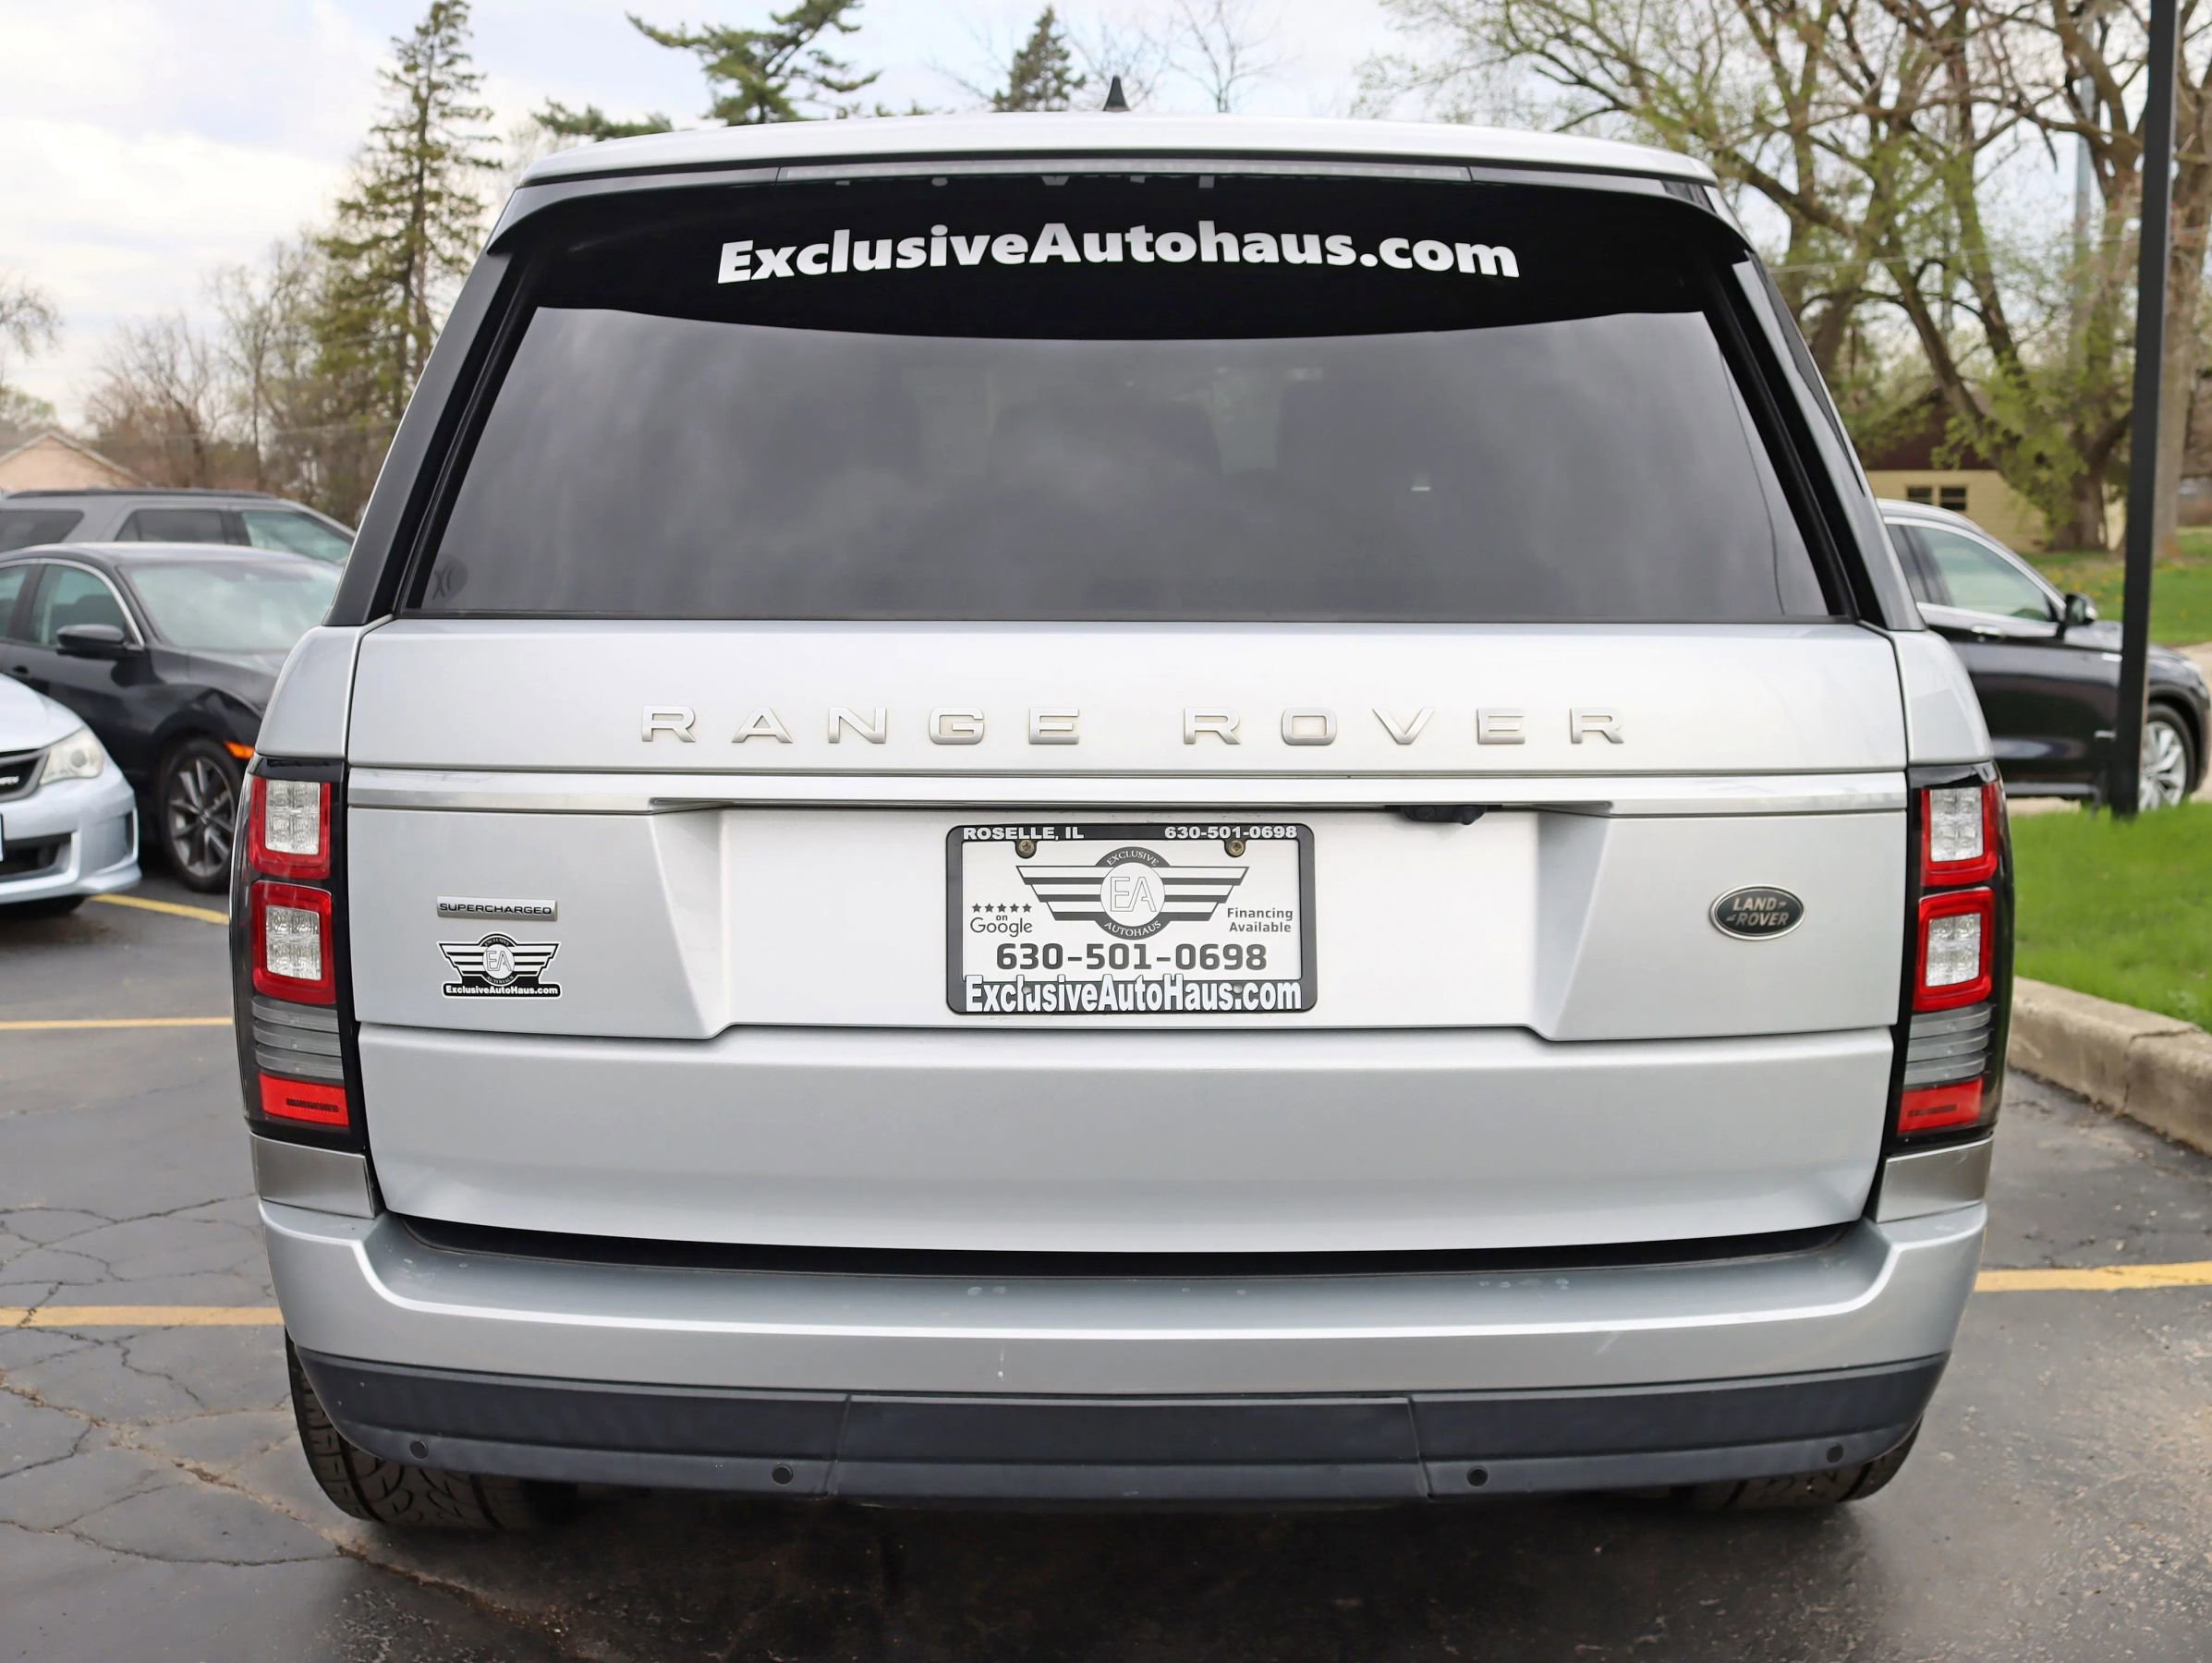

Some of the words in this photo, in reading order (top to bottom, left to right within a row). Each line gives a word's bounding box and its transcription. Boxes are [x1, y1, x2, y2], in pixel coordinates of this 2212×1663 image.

[717, 221, 1520, 285] ExclusiveAutohaus.com
[641, 705, 1080, 746] RANGE
[1184, 706, 1625, 746] ROVER
[963, 827, 1059, 841] ROSELLE,
[1065, 827, 1085, 840] IL
[1164, 825, 1298, 839] 630-501-0698
[1106, 849, 1160, 867] EXCLUSIVE
[1110, 876, 1157, 913] EA
[439, 903, 553, 915] SUPERCHARGED
[1732, 897, 1778, 911] LAND
[995, 914, 1009, 922] on
[1226, 907, 1294, 921] Financing
[1736, 912, 1790, 927] ROVER
[969, 916, 1034, 938] Google
[1103, 920, 1162, 937] AUTOHAUS
[1228, 921, 1293, 933] Available
[485, 950, 512, 972] EA
[995, 942, 1268, 971] 630-501-0698
[445, 985, 558, 995] ExclusiveAutoHaus.com
[965, 974, 1303, 1013] ExclusiveAutoHaus.com
